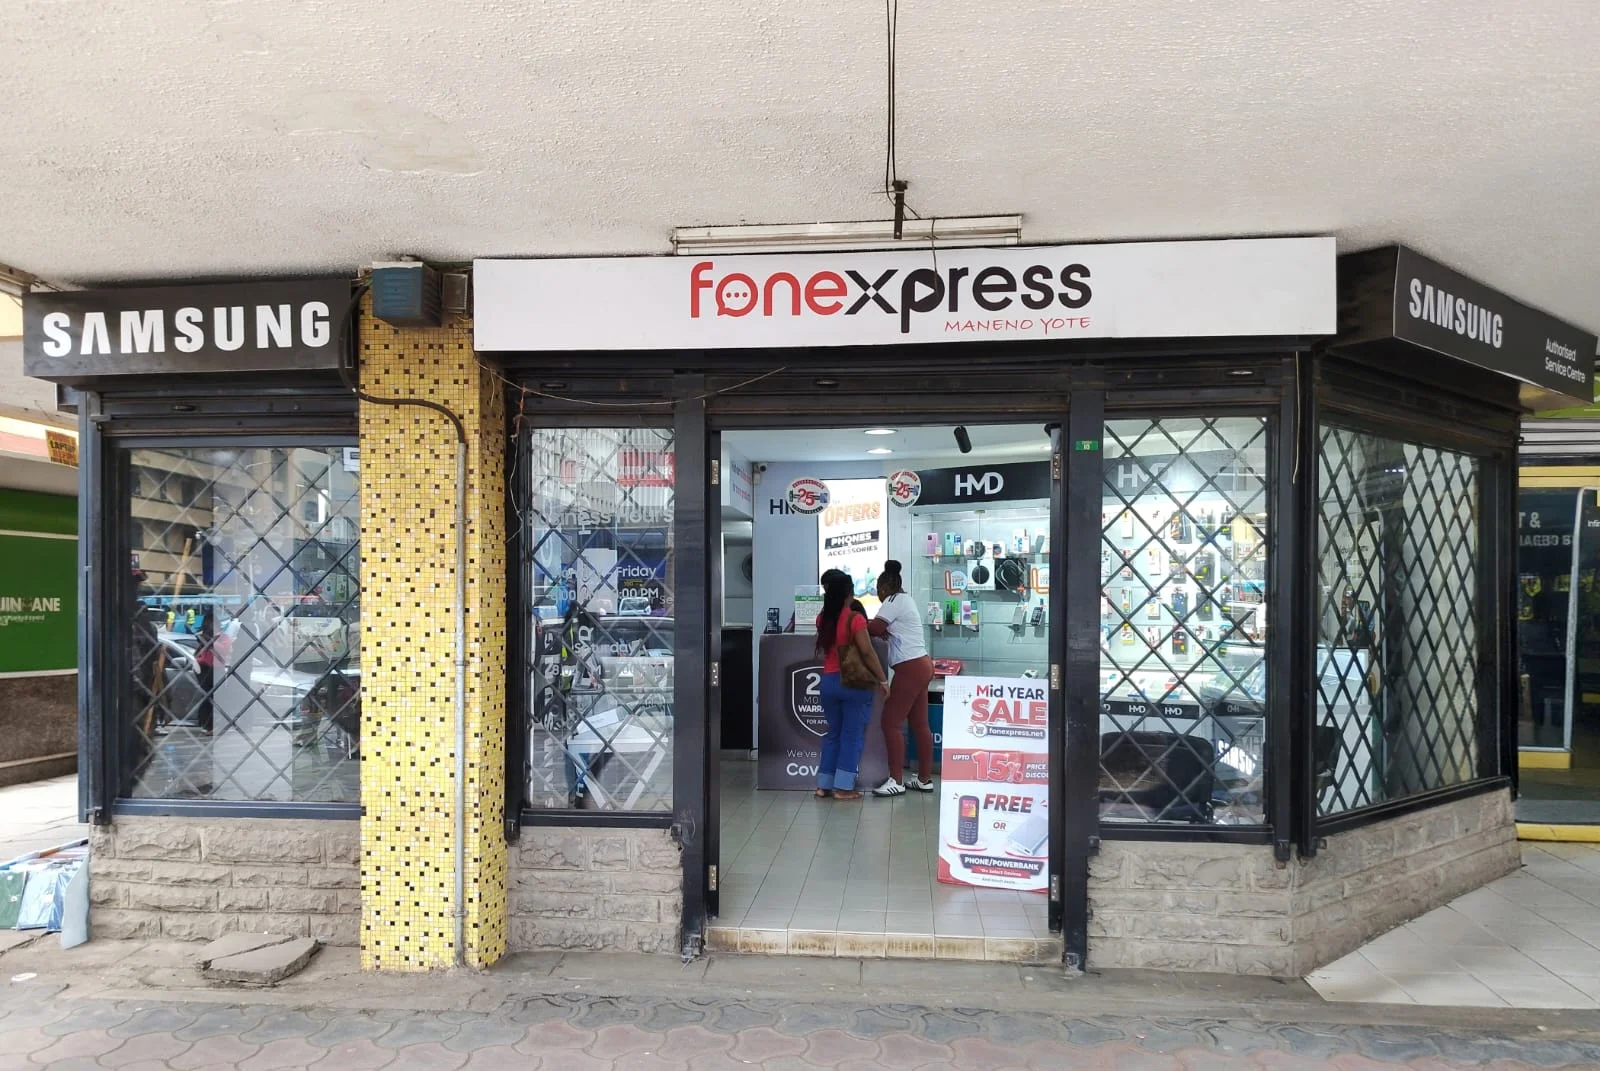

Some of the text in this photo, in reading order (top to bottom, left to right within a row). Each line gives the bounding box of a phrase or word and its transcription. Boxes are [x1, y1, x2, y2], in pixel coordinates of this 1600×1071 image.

[691, 261, 1091, 333] fonexpress
[1409, 278, 1503, 348] SAMSUNG
[42, 301, 330, 357] SAMSUNG
[944, 317, 1091, 335] MANENO YOTE
[1546, 338, 1576, 361] Authorised
[1545, 357, 1585, 383] Service Centre
[954, 472, 1004, 496] HMD
[824, 502, 880, 526] OFFERS
[831, 532, 872, 547] PHONES
[828, 545, 878, 556] ACCESSORIES
[616, 565, 657, 580] Friday
[640, 588, 658, 598] PM
[976, 684, 1045, 700] Mid YEAR
[970, 698, 1048, 726] SALE
[1128, 704, 1146, 713] HMD
[1164, 706, 1183, 716] HMD
[988, 727, 1044, 738] fonexpress.net
[983, 793, 1034, 814] FREE
[993, 821, 1006, 830] OR
[964, 856, 1040, 871] PHONE/POWERBANK
